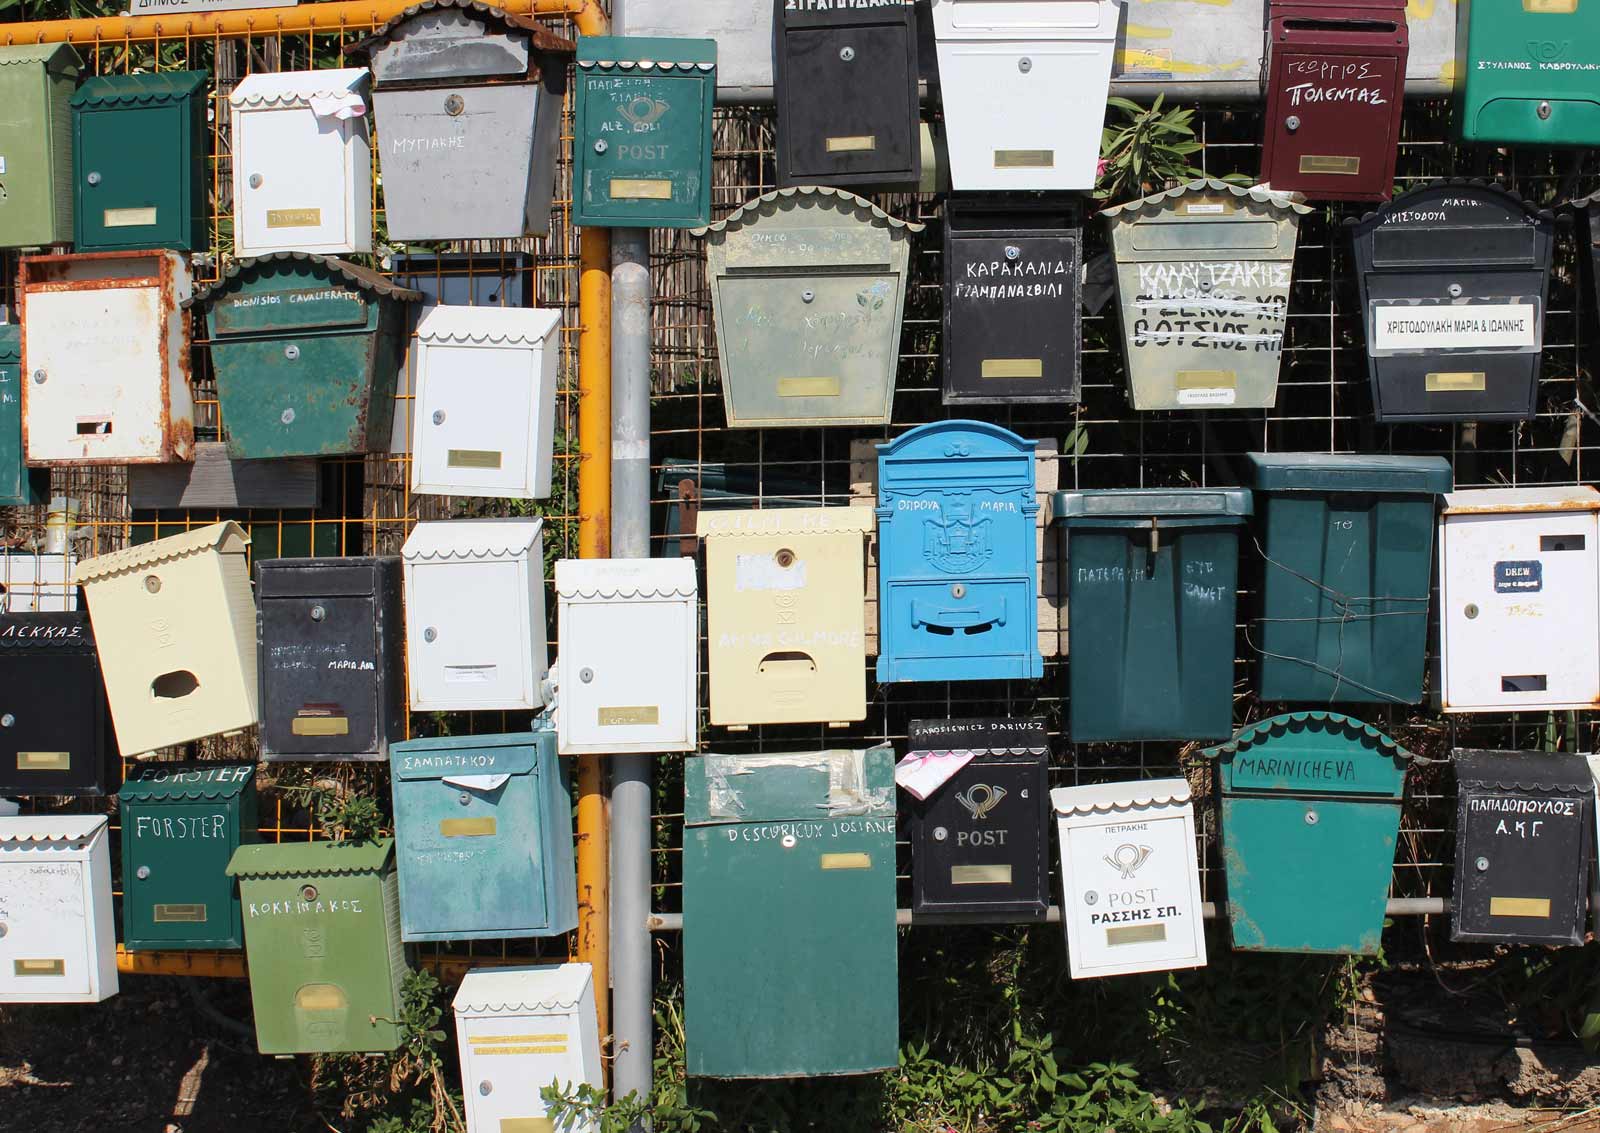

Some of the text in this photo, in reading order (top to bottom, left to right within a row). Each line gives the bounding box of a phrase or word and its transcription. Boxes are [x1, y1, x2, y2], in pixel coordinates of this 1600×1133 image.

[1285, 82, 1387, 106] ΠΟΛΕΝΤΑΣ
[617, 145, 669, 160] POST
[1454, 319, 1479, 333] ΜΑΡΙΑ
[1481, 320, 1487, 333] &
[1488, 319, 1525, 332] ΙΩΑΝΝΗΣ
[1505, 567, 1531, 577] DREW
[991, 722, 1043, 731] DARIUSZ
[1239, 758, 1356, 781] MARINICHEVA
[1471, 799, 1575, 816] ΠΑΠΑΔΟΠΟΥΛΟΣ
[137, 815, 226, 839] FORSTER
[1105, 823, 1149, 834] ΠΕΤΡΑΚΗΣ
[957, 829, 1009, 846] POST
[1108, 888, 1160, 908] POST
[1091, 905, 1182, 925] ΡΑΣΣΗΣ ΣΠ.
